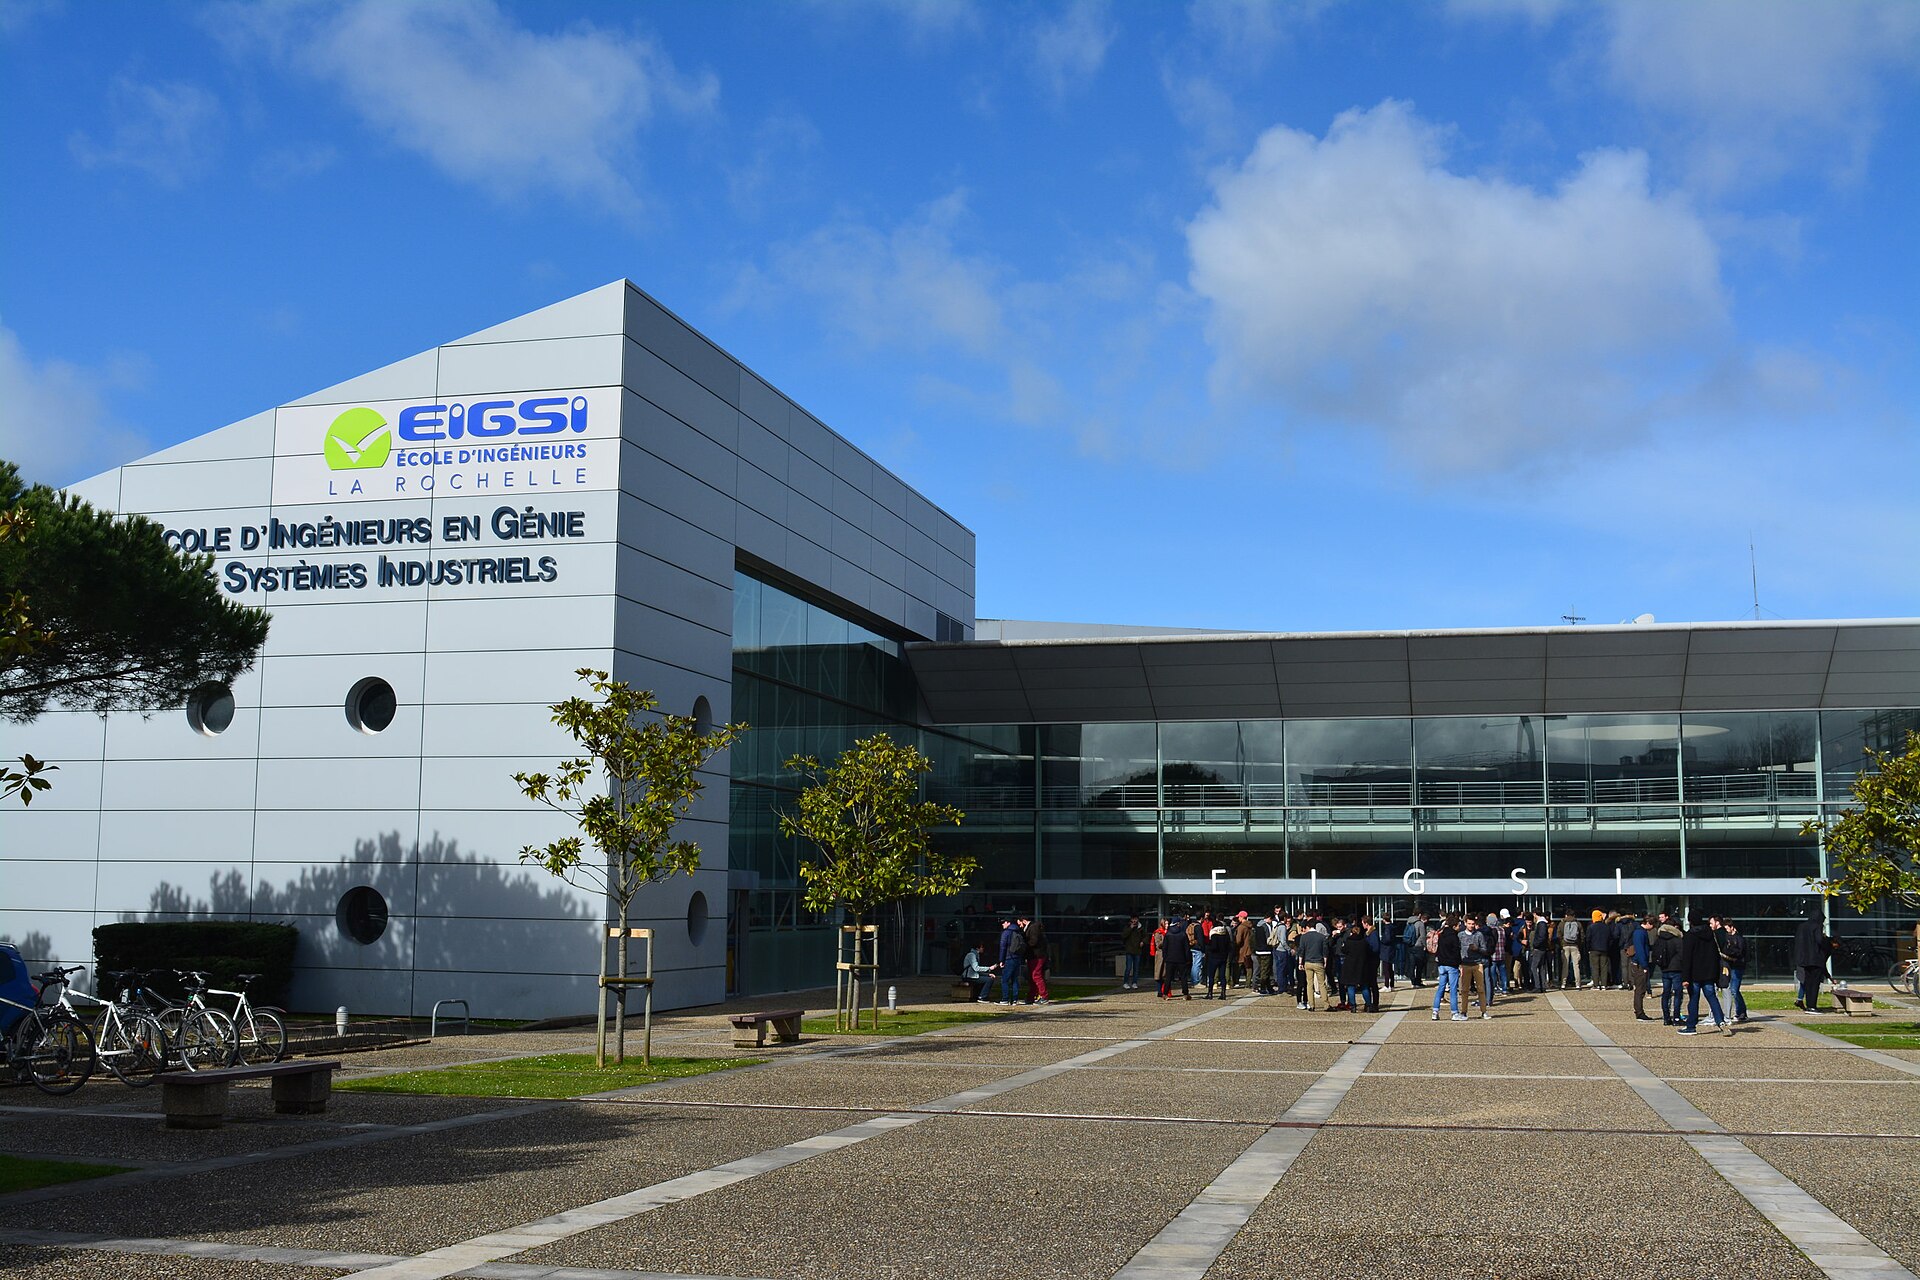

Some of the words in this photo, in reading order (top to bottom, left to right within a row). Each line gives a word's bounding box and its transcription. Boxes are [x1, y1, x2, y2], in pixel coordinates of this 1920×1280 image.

[396, 449, 453, 468] ÉCOLE
[328, 479, 364, 497] LA
[395, 467, 587, 492] ROCHELLE
[150, 524, 232, 553] COLE
[441, 514, 481, 543] EN
[490, 505, 586, 542] GÉNIE
[223, 559, 368, 594] SYSTÈMES
[377, 554, 559, 588] INDUSTRIELS
